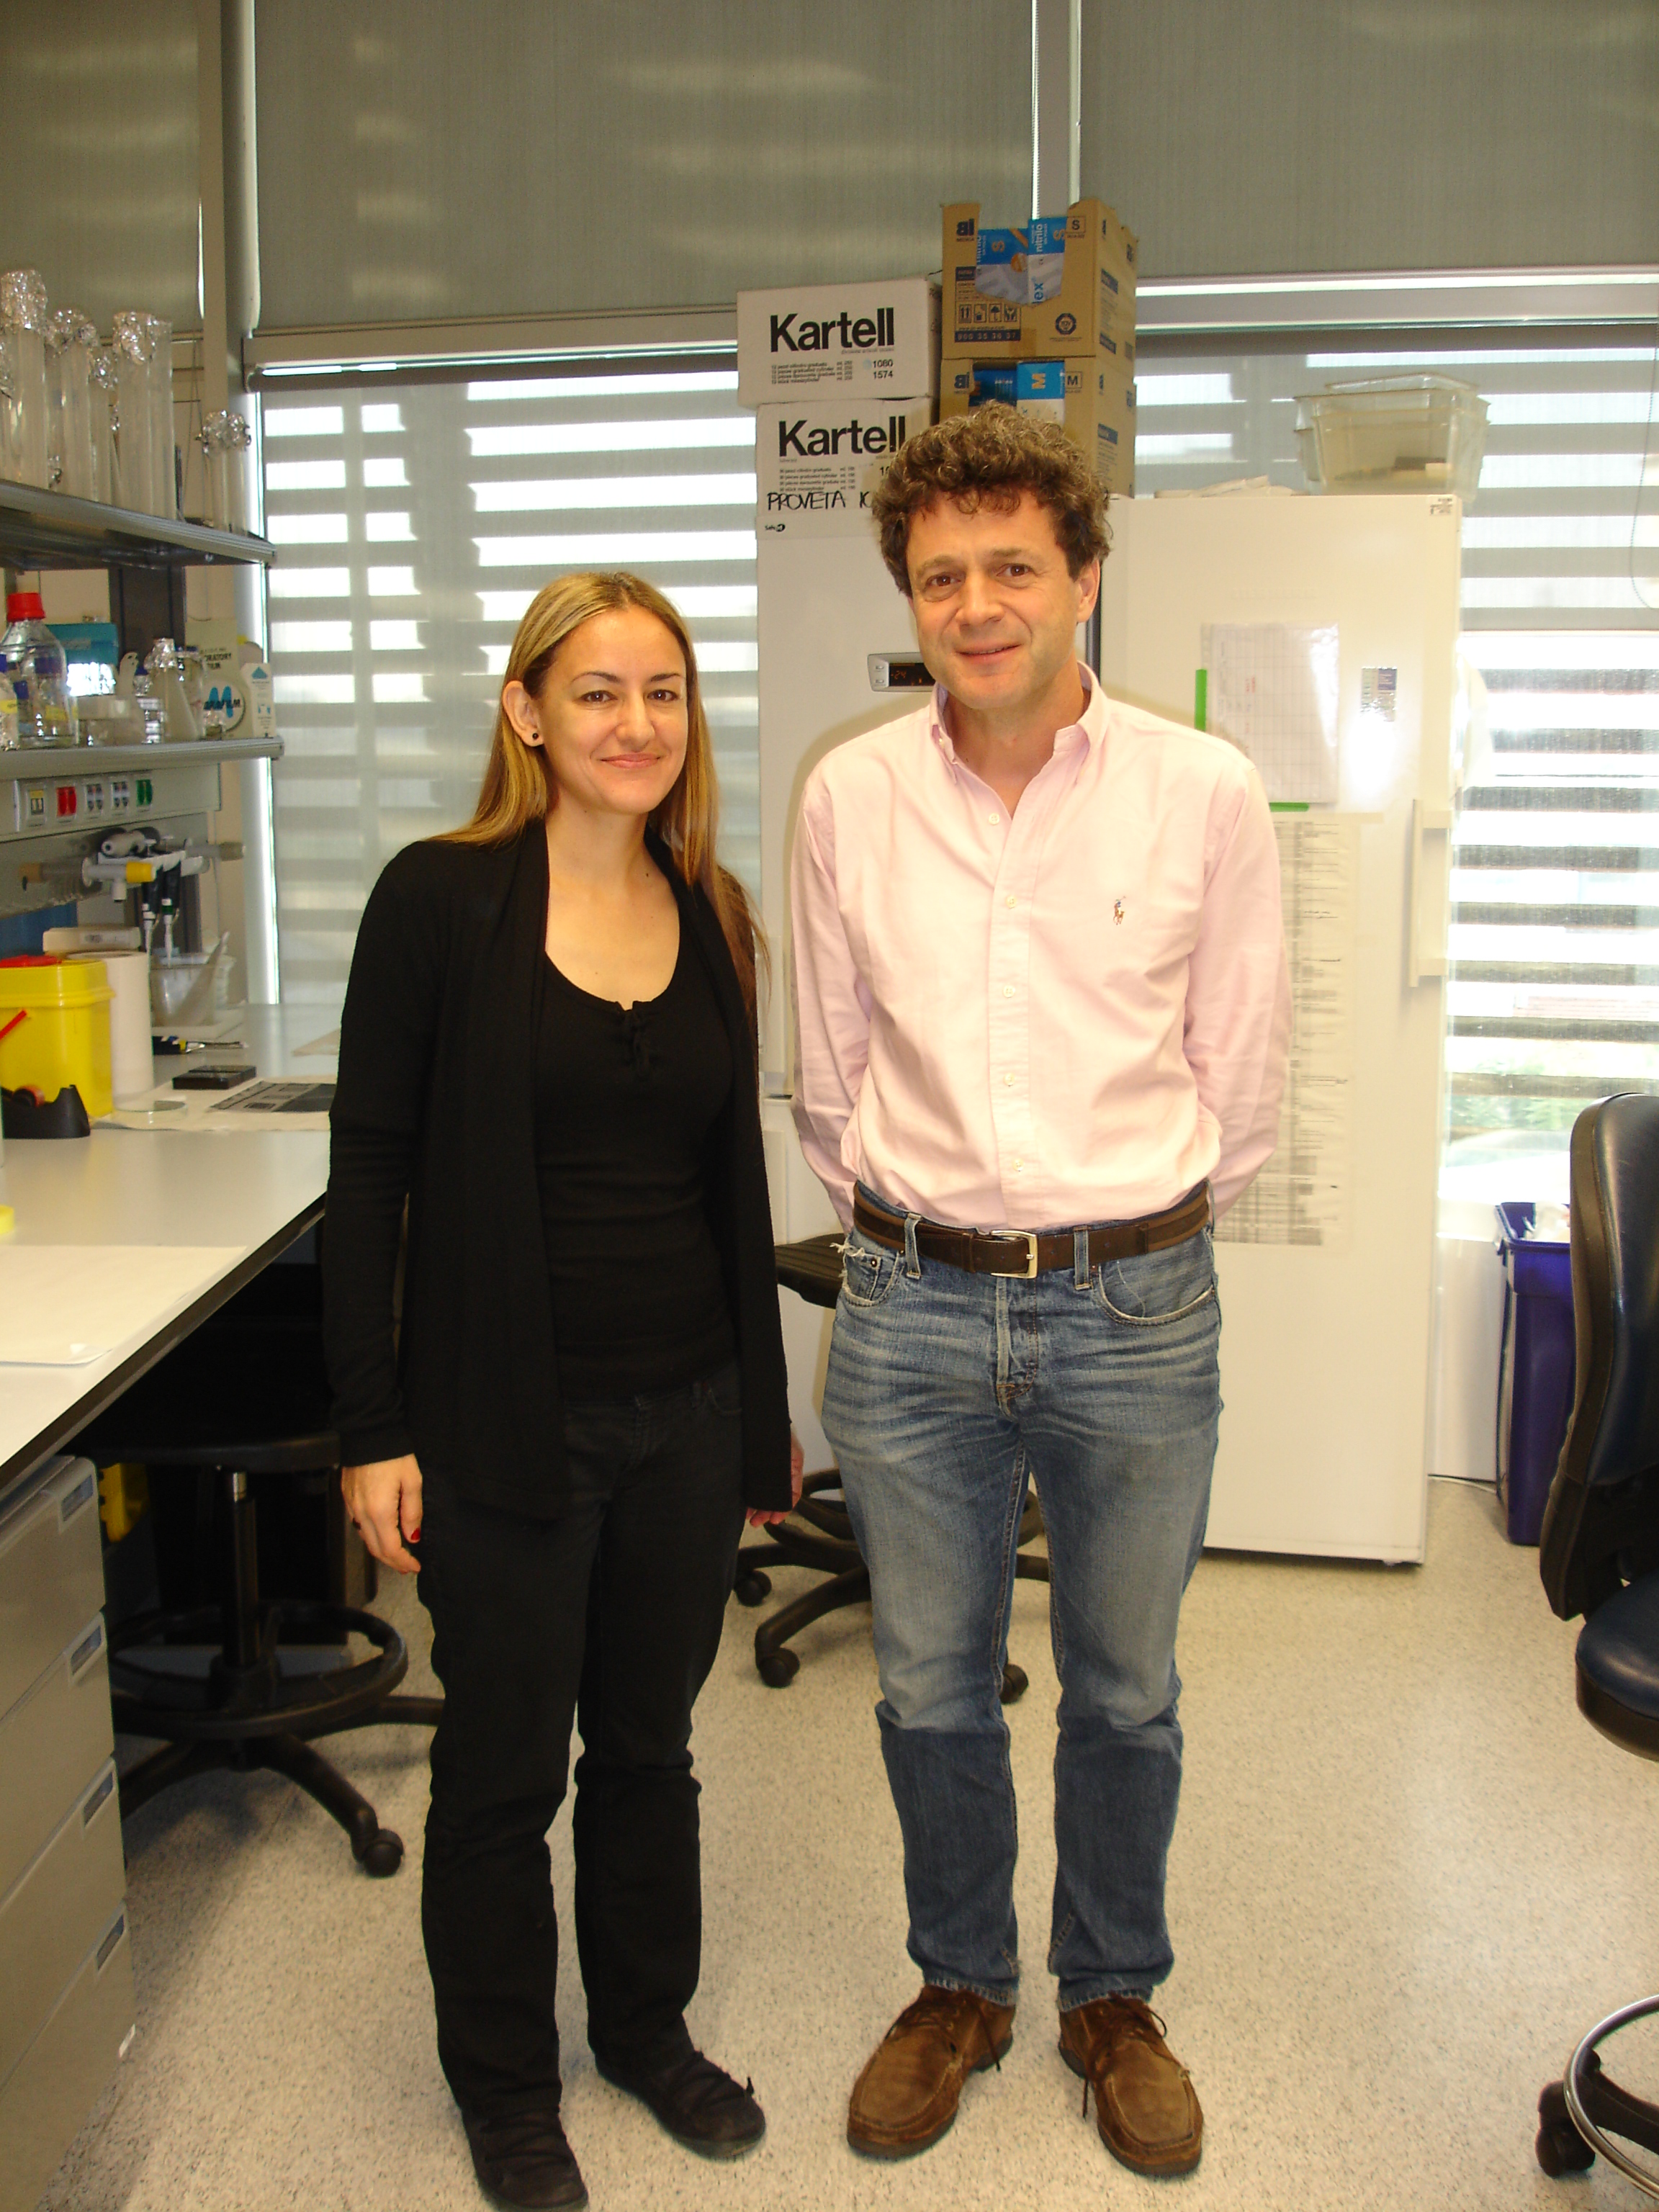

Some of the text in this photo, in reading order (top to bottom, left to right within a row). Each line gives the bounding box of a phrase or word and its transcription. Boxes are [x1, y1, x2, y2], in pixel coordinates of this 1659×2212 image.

[1071, 219, 1080, 230] S
[992, 240, 1005, 253] S
[770, 307, 894, 353] Kartell
[873, 370, 894, 379] 1574
[1032, 373, 1046, 390] M
[1067, 375, 1079, 386] M
[778, 415, 907, 457] Kartell
[767, 490, 845, 511] PROVETA
